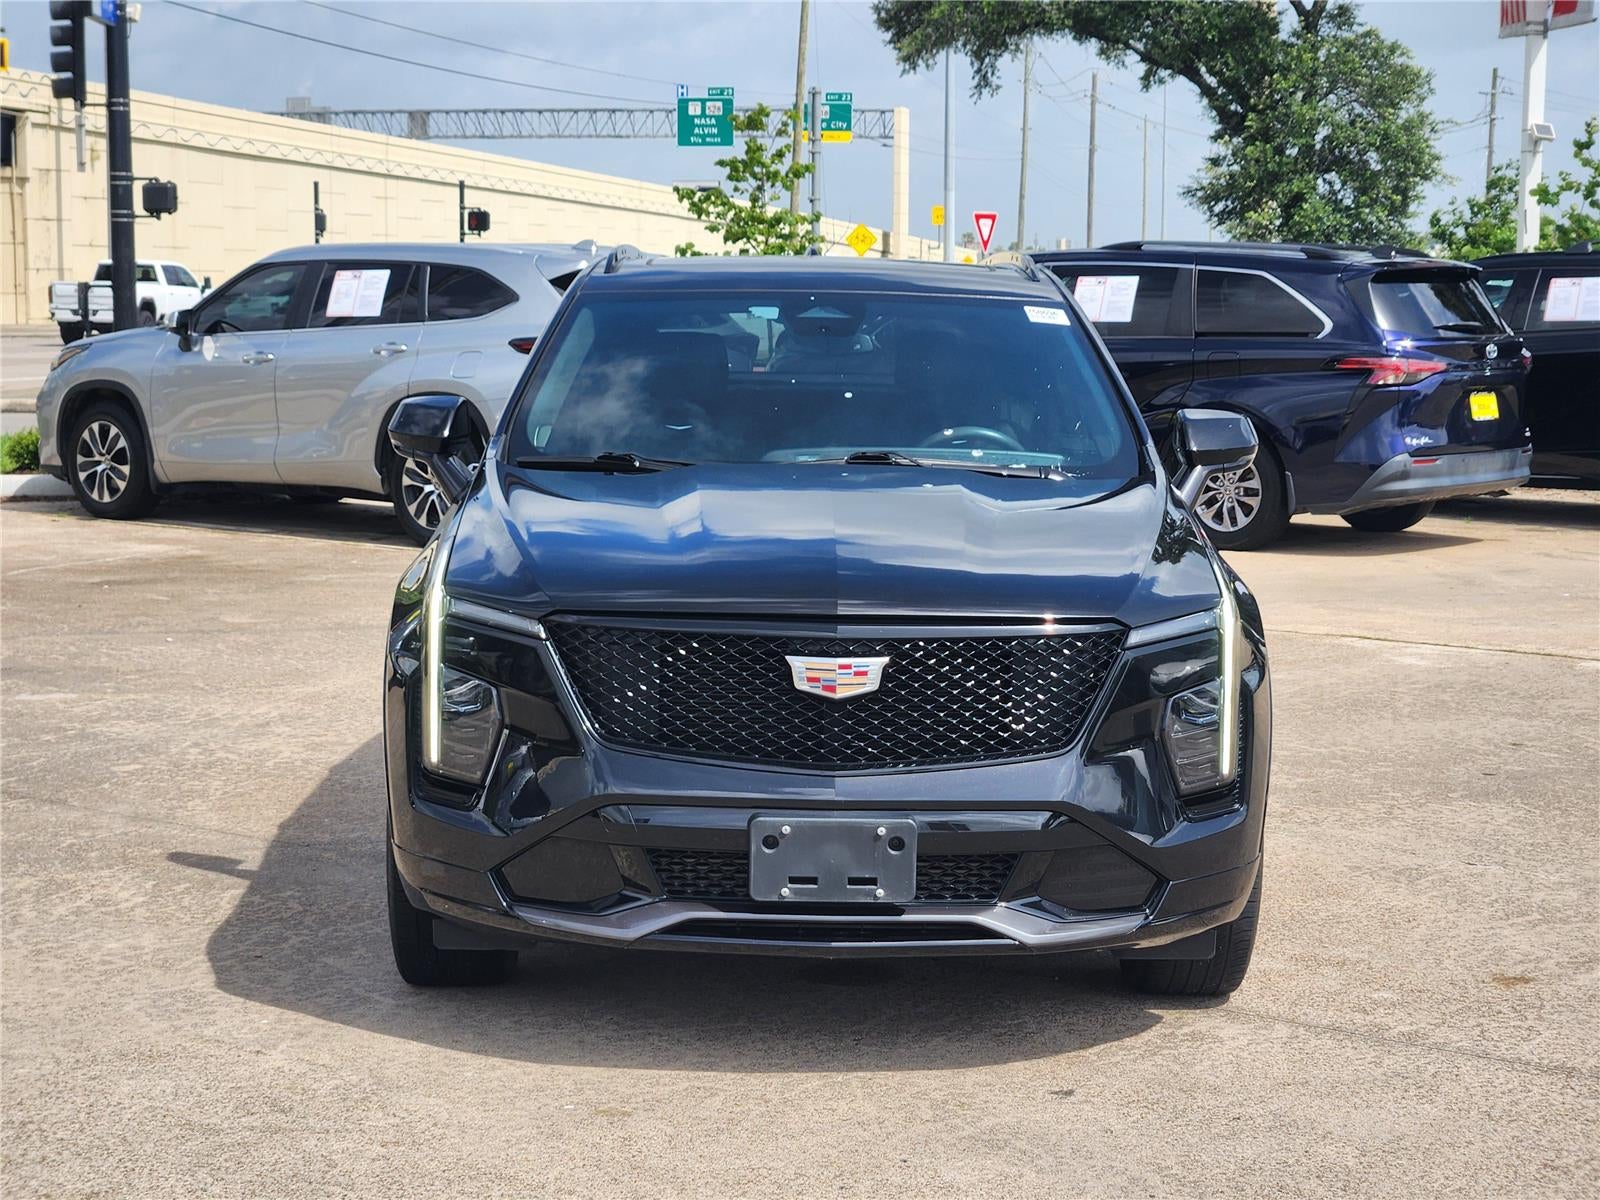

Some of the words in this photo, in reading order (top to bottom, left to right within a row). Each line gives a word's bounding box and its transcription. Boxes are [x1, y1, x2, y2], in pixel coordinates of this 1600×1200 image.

[694, 117, 716, 125] NASA
[830, 120, 847, 129] City
[694, 127, 718, 135] ALVIN
